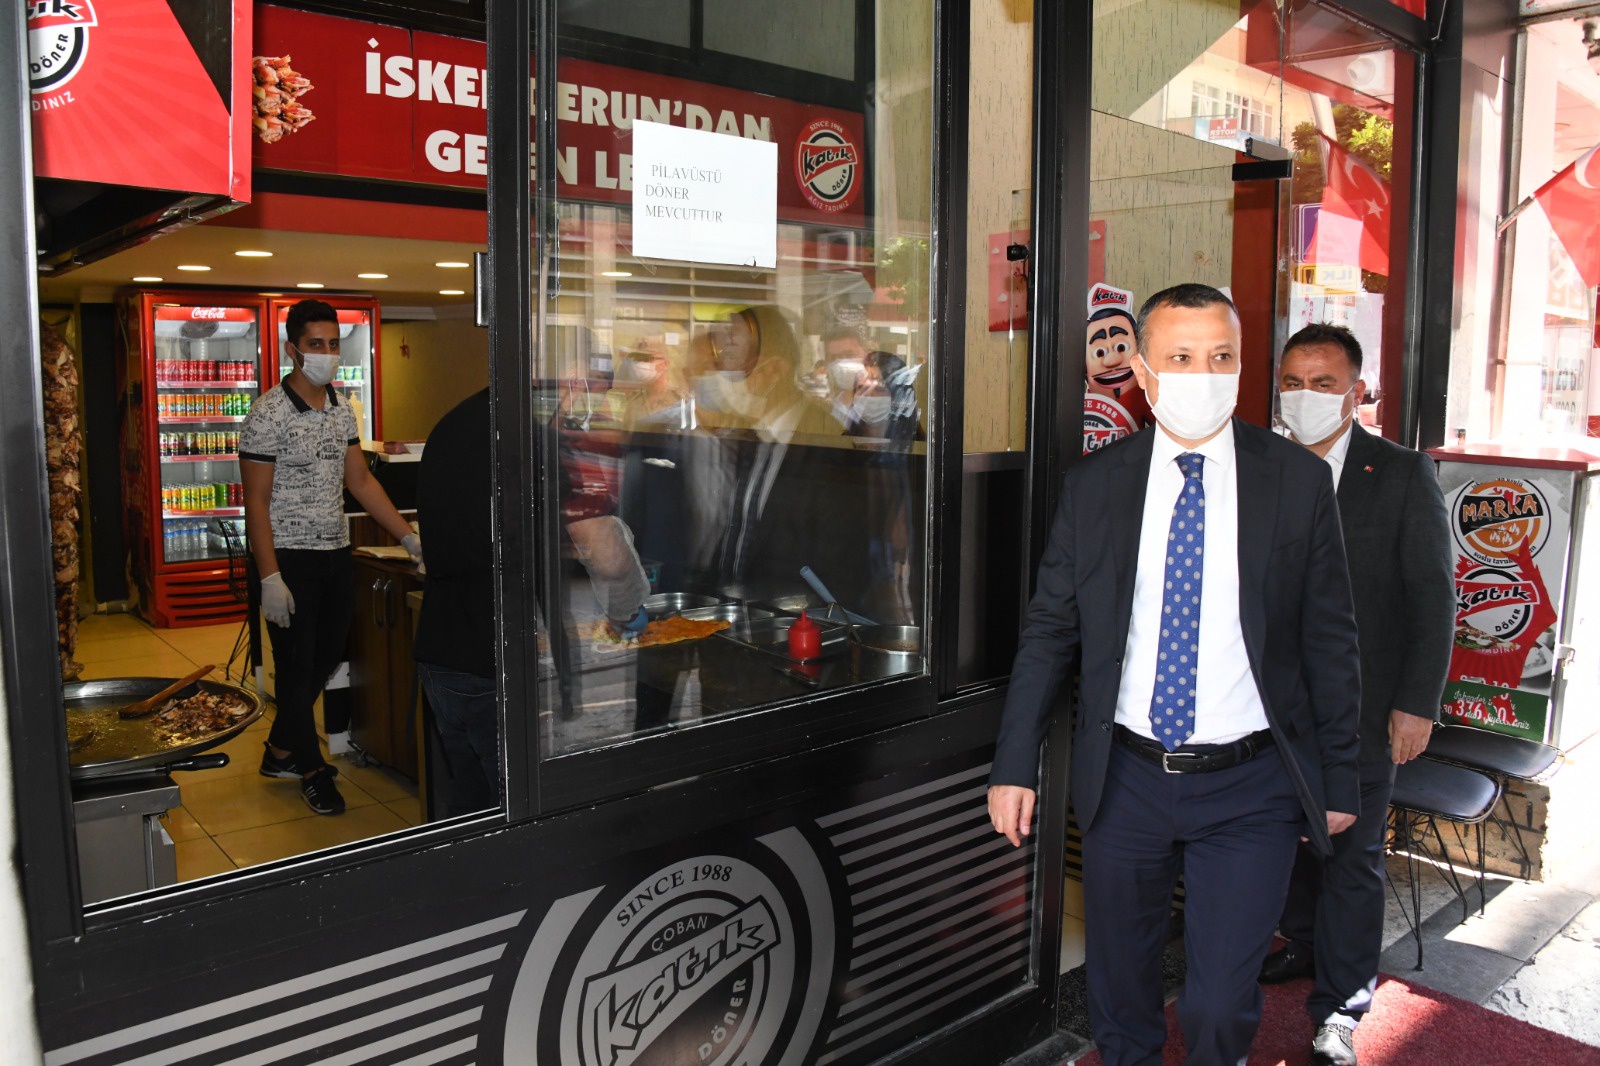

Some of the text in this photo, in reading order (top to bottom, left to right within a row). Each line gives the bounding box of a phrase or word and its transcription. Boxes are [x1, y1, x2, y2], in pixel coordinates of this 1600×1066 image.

[651, 162, 722, 184] PİLAVÜSTÜ
[645, 182, 690, 200] DÖNER
[645, 204, 723, 223] MEVCUTTUR
[1096, 402, 1118, 419] 1988
[1462, 495, 1538, 523] MARKA
[616, 864, 733, 928] SINCE 1988
[651, 915, 708, 952] ÇOBAN
